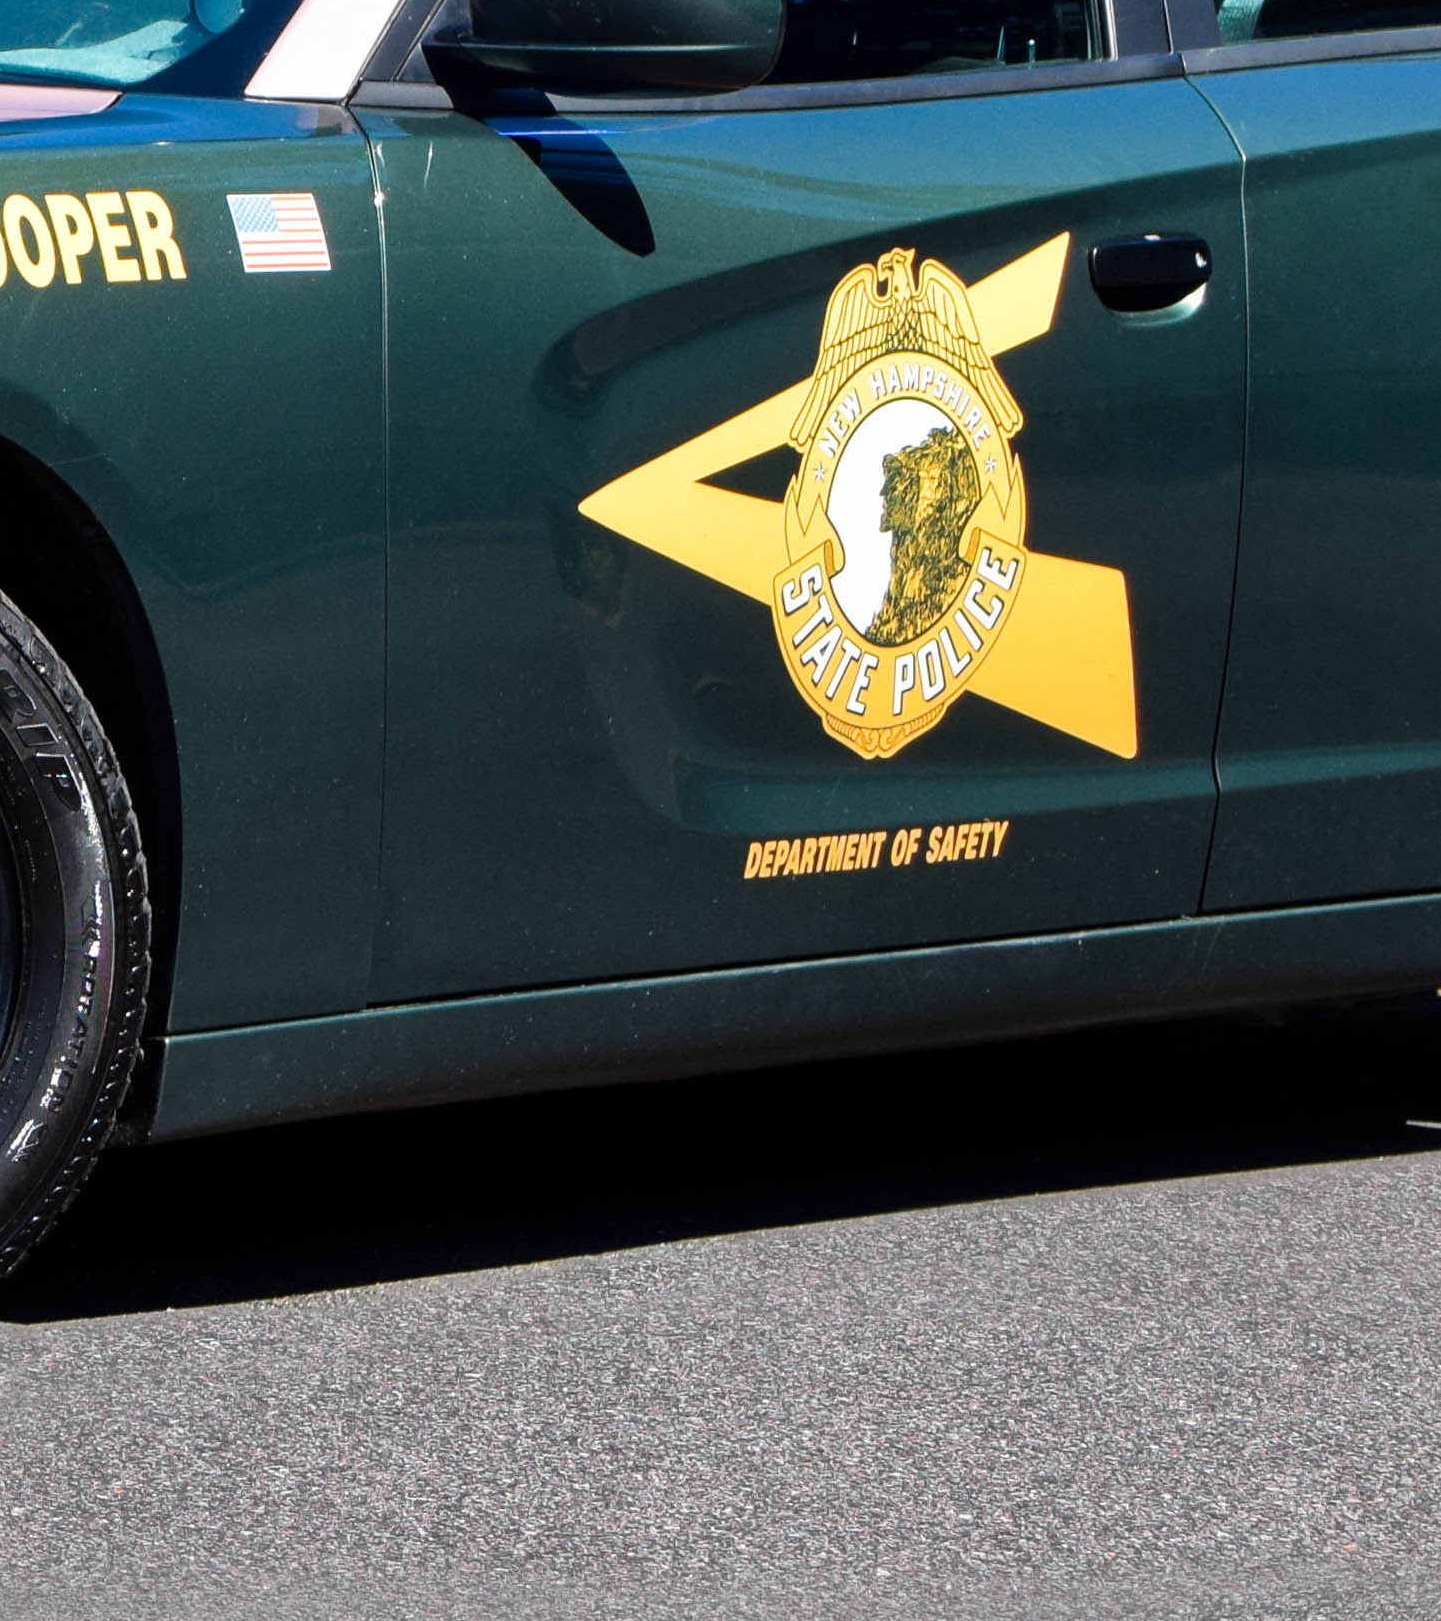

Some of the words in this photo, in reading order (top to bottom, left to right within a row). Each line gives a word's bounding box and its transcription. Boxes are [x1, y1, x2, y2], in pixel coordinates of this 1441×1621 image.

[818, 387, 863, 459] NEW
[869, 362, 992, 449] HAMPSHIRE
[781, 561, 880, 716] STATE
[892, 546, 1019, 716] POLICE
[743, 831, 888, 879] DEPARTMENT
[890, 827, 923, 868] OF
[925, 820, 1009, 864] SAFETY
